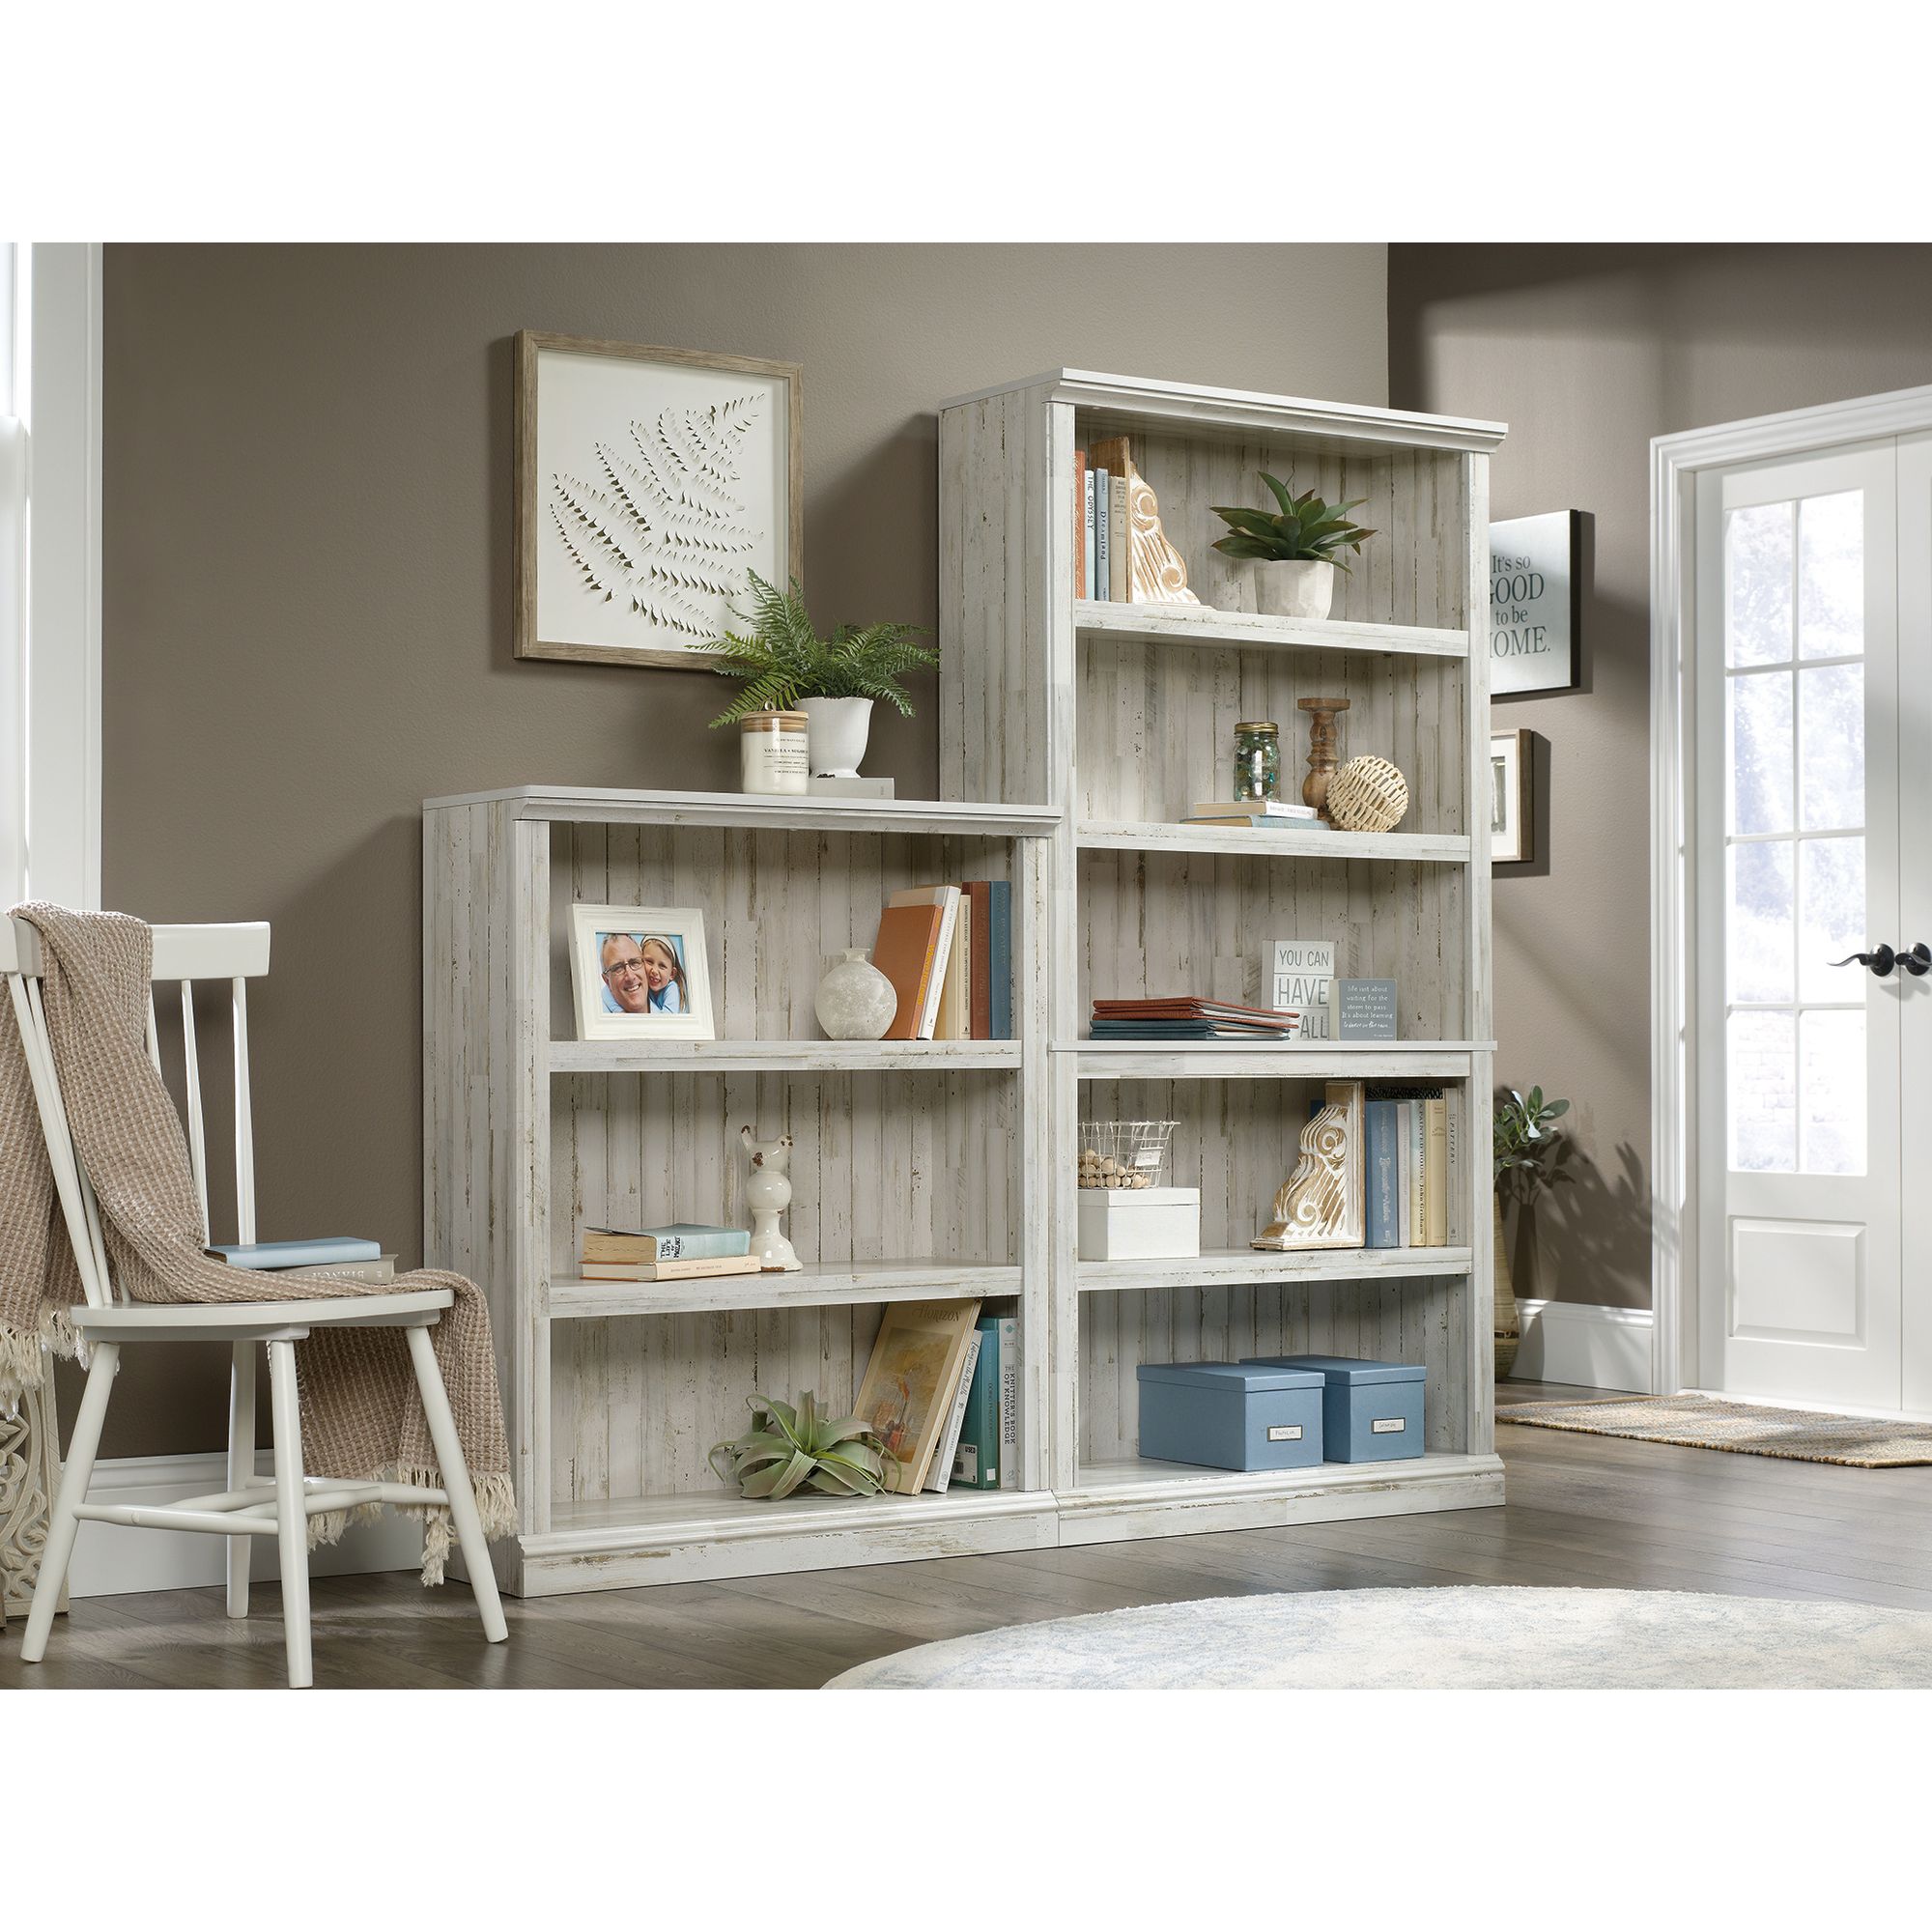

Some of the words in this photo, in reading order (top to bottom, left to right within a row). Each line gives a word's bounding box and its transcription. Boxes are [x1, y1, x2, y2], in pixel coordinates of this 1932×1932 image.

[1492, 555, 1512, 573] It's
[1516, 555, 1531, 570] so
[1495, 611, 1509, 626] to
[1512, 605, 1528, 623] be
[1279, 950, 1302, 967] YOU
[1307, 951, 1329, 967] CAN
[1278, 978, 1328, 1005] HAVE
[1299, 1014, 1328, 1038] ALL
[1004, 1373, 1010, 1384] OF
